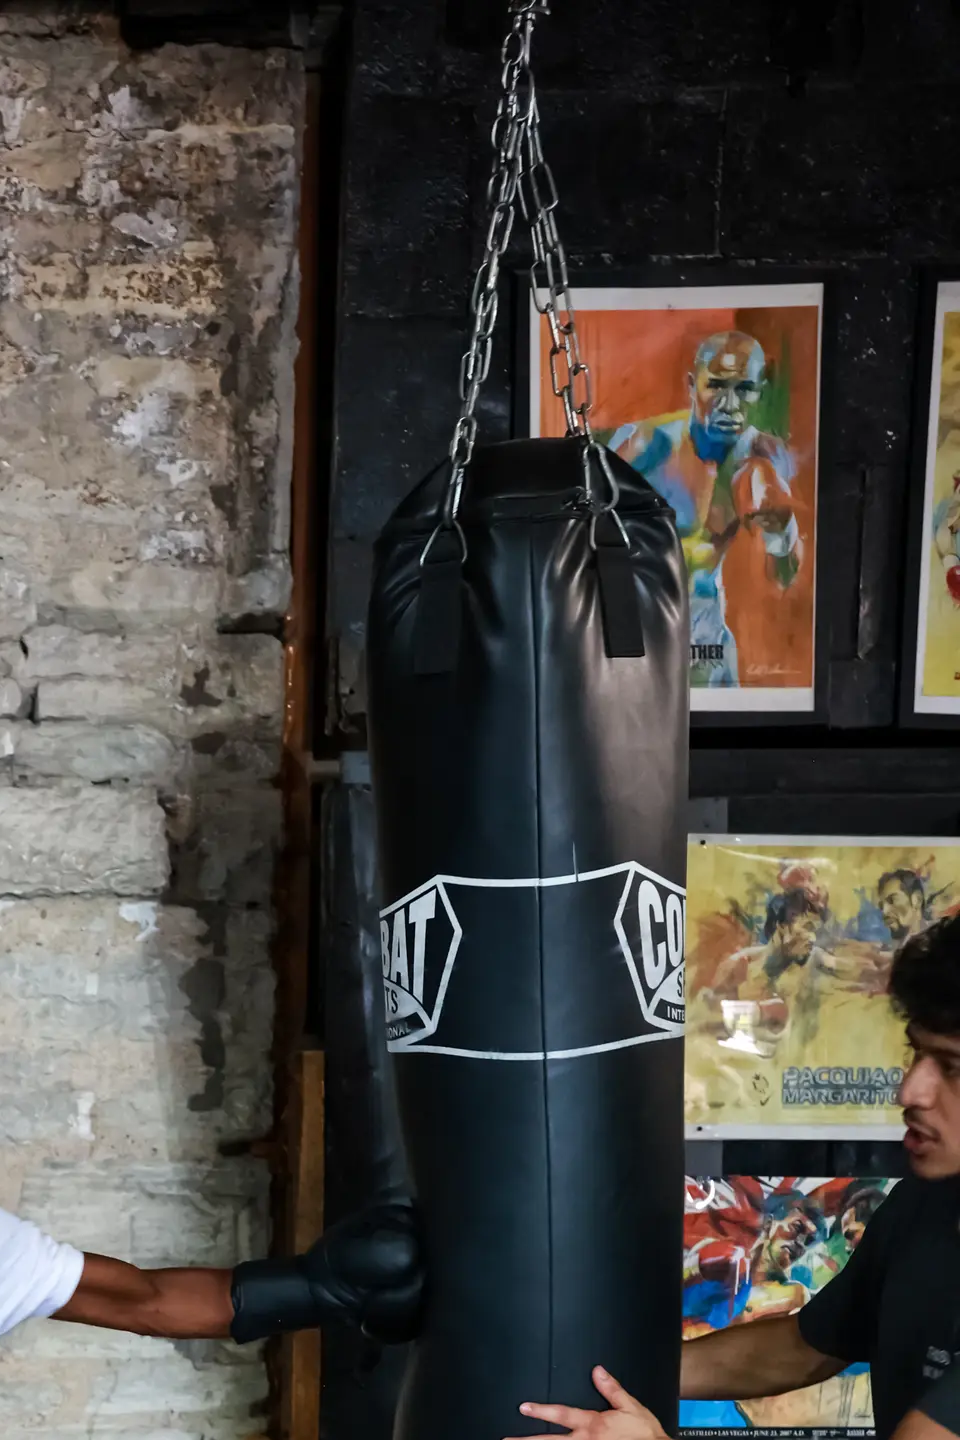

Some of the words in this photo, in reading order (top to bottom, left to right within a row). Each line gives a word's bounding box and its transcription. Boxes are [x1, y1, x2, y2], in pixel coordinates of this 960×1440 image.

[638, 879, 686, 990] CO
[782, 1066, 904, 1086] PACQUIAO
[683, 1429, 714, 1437] CASTILLO
